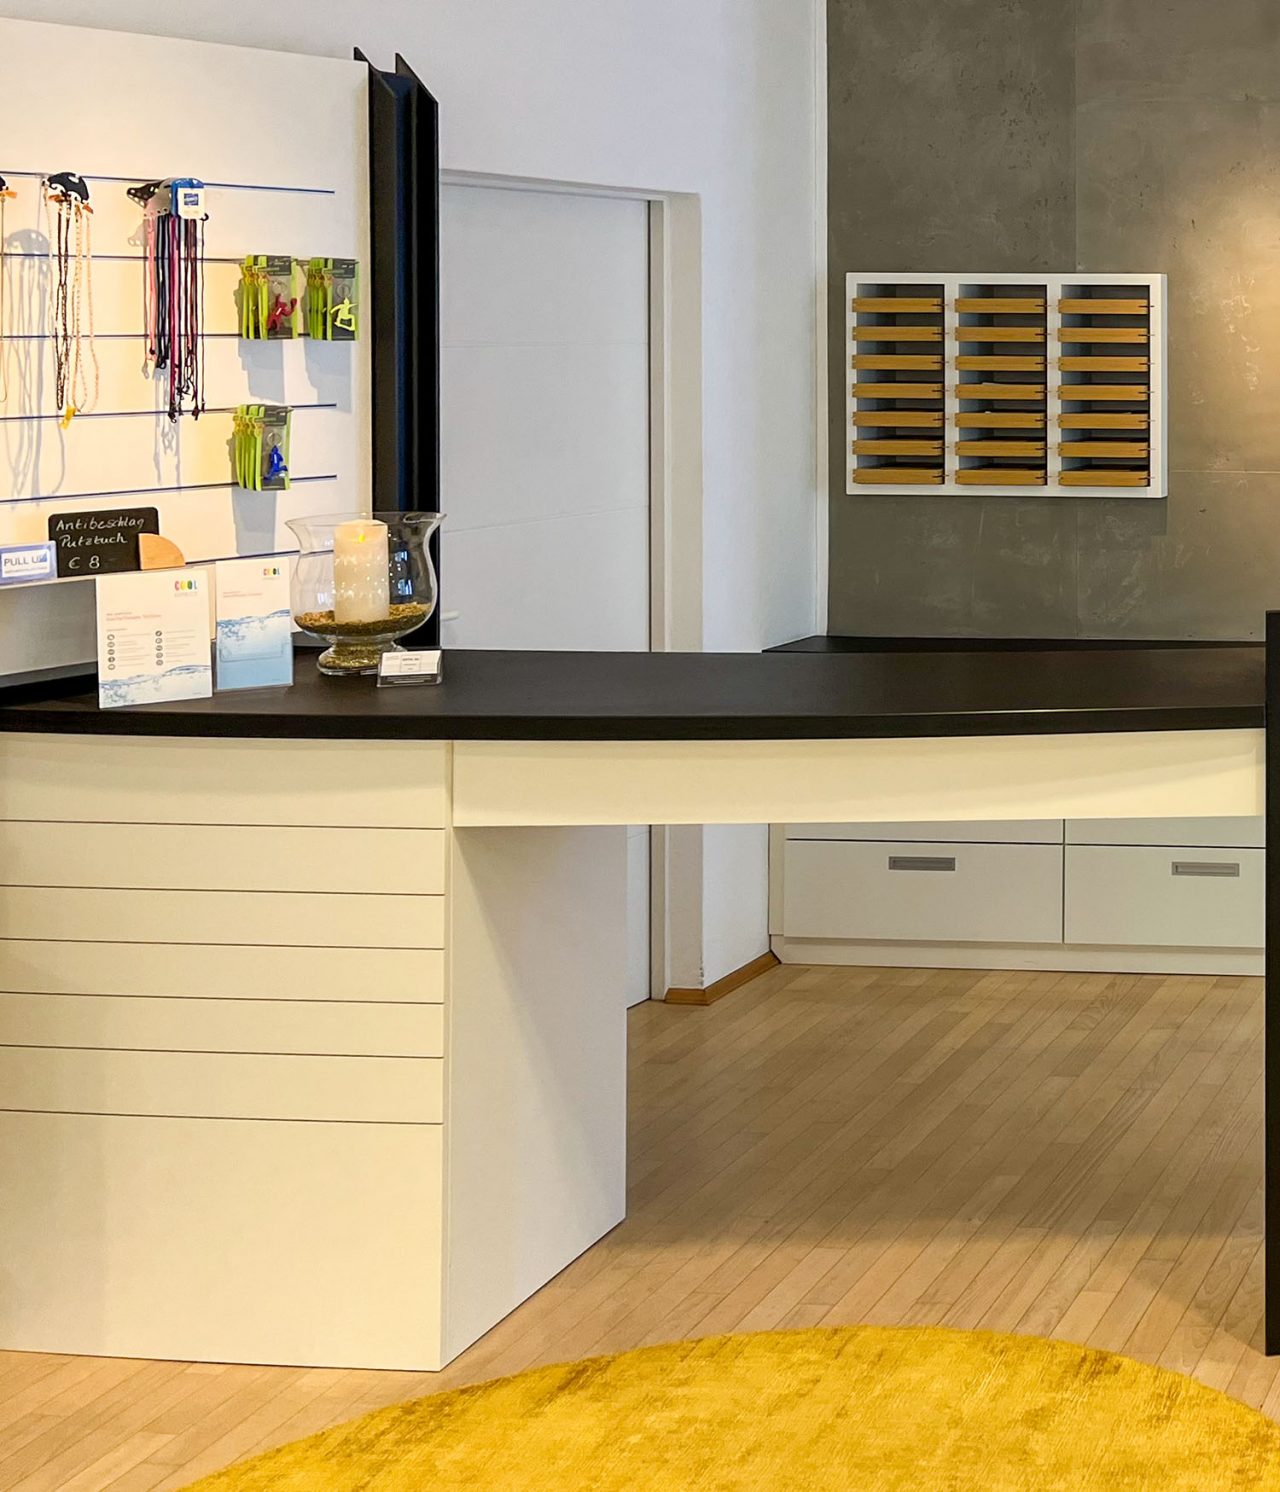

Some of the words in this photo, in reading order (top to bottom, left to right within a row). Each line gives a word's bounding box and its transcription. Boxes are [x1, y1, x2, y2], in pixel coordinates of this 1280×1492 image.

[55, 516, 145, 531] Antibeschlag
[59, 532, 128, 548] Putztuch
[4, 557, 30, 567] PULL
[88, 555, 100, 569] 8
